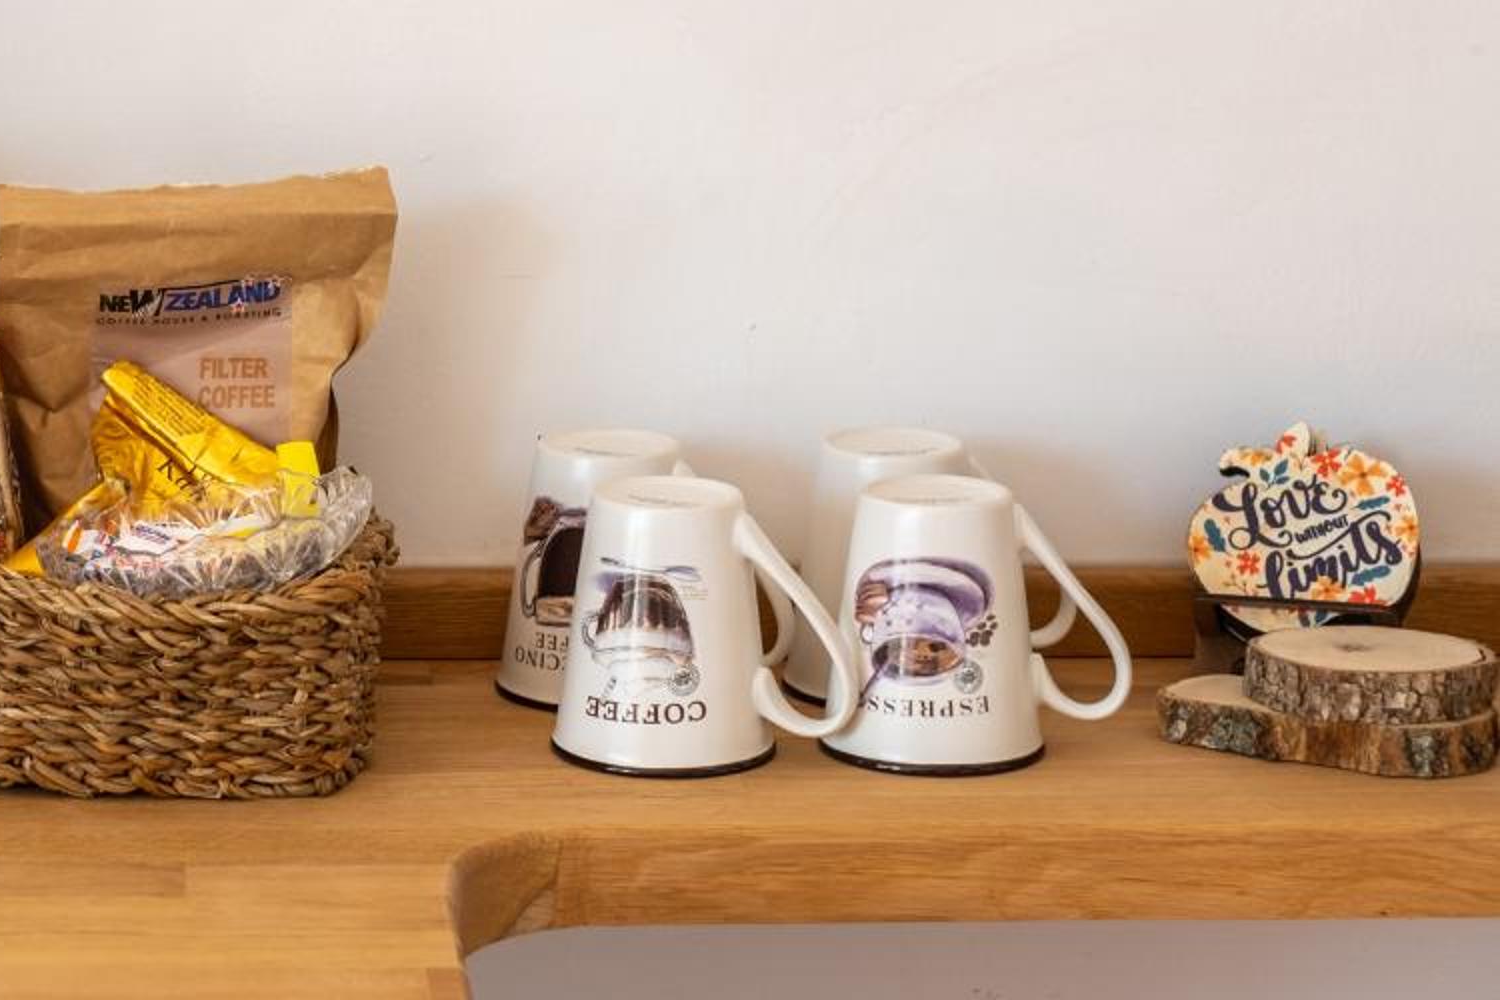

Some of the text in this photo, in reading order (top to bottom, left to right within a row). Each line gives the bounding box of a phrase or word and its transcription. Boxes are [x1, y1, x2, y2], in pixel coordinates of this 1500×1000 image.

[100, 279, 282, 316] NEW ZEALAND
[200, 357, 268, 380] FILTER
[199, 384, 275, 409] COFFEE
[1211, 474, 1348, 550] Love
[585, 694, 708, 725] COFFEE
